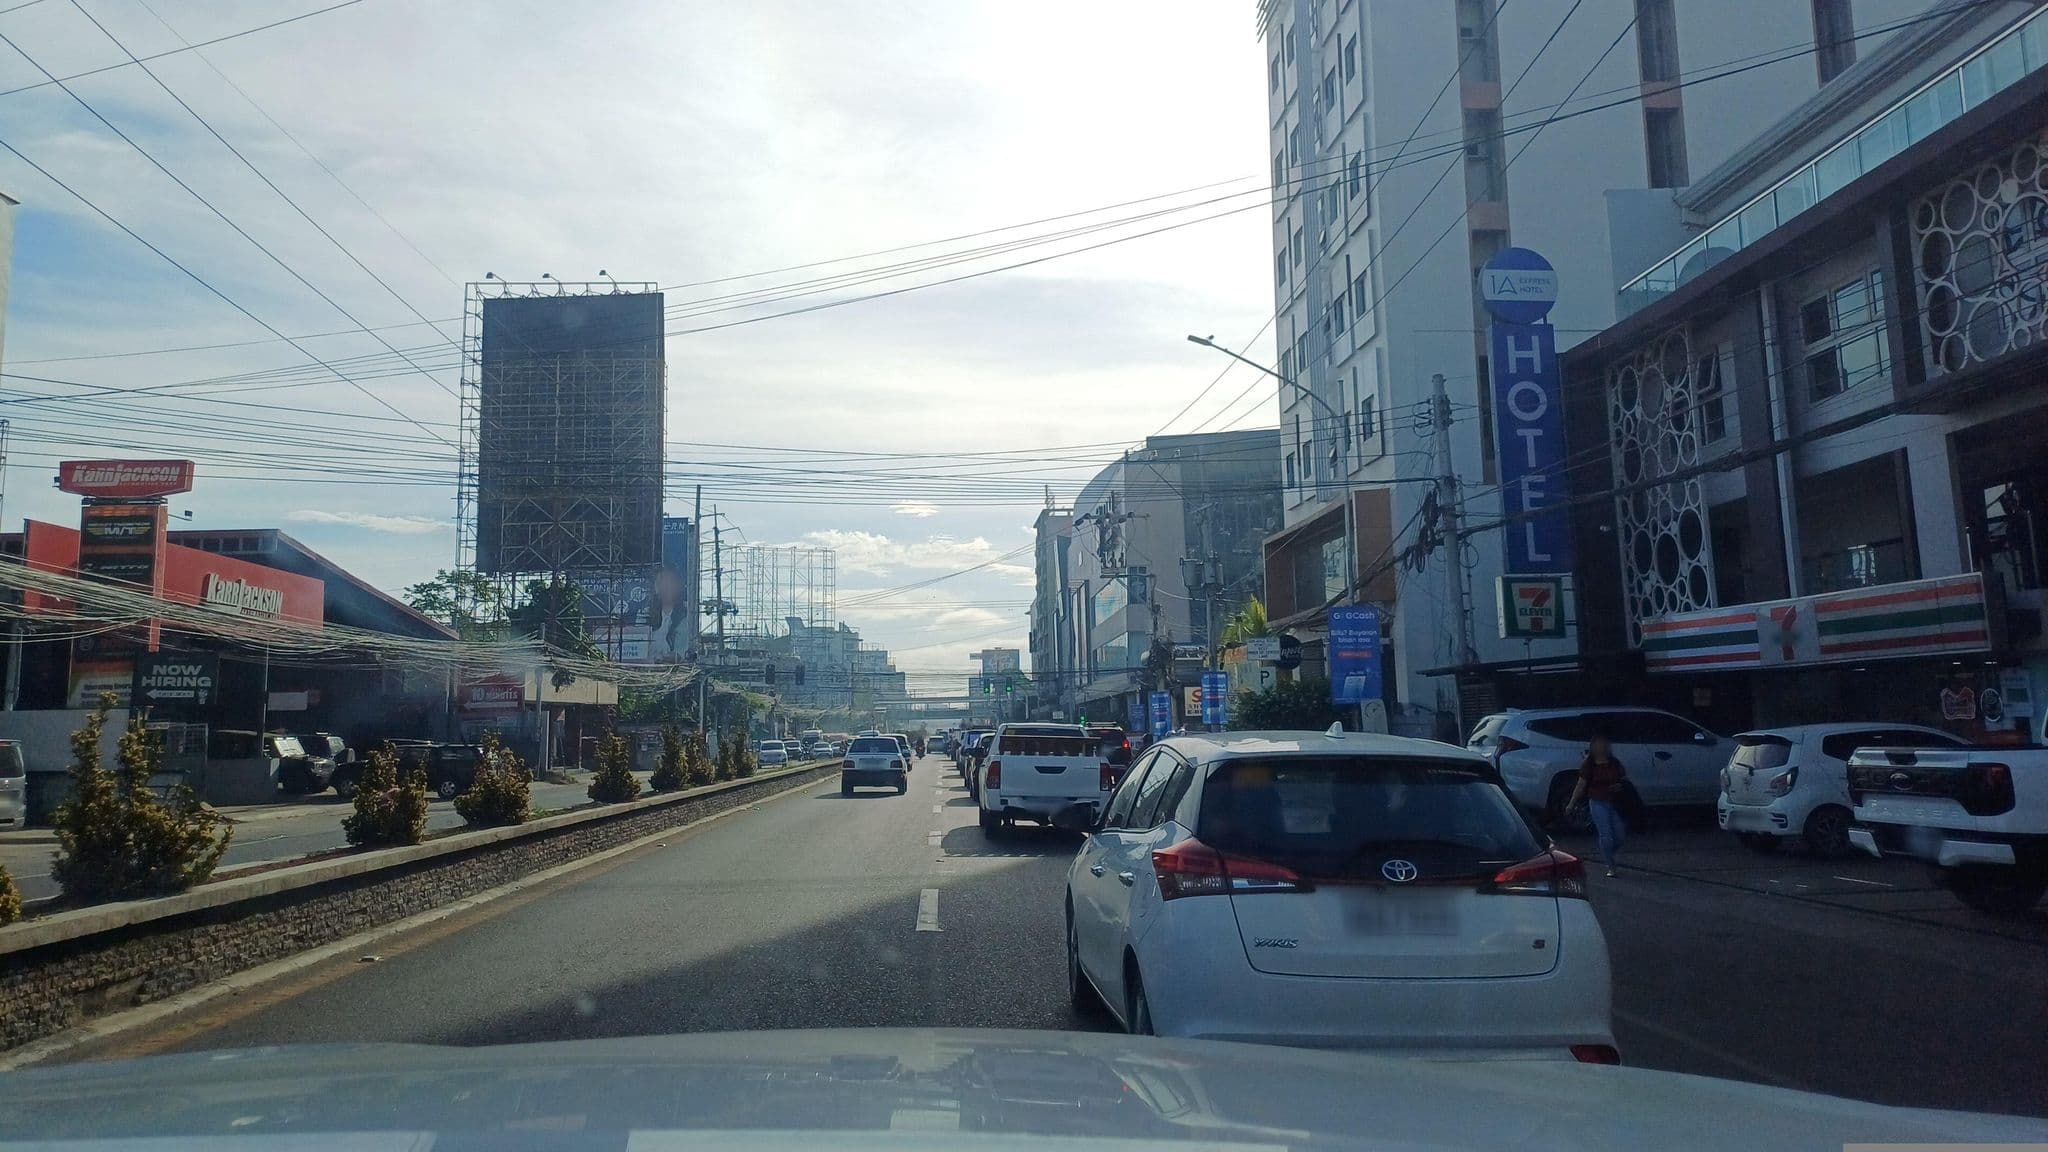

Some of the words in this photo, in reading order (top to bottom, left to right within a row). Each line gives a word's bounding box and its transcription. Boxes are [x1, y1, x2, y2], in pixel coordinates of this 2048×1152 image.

[1507, 335, 1551, 562] HOTEL
[1345, 612, 1375, 620] GCash
[1770, 605, 1797, 661] 7
[152, 664, 202, 676] NOW
[141, 676, 212, 687] HIRING
[1260, 670, 1270, 684] P
